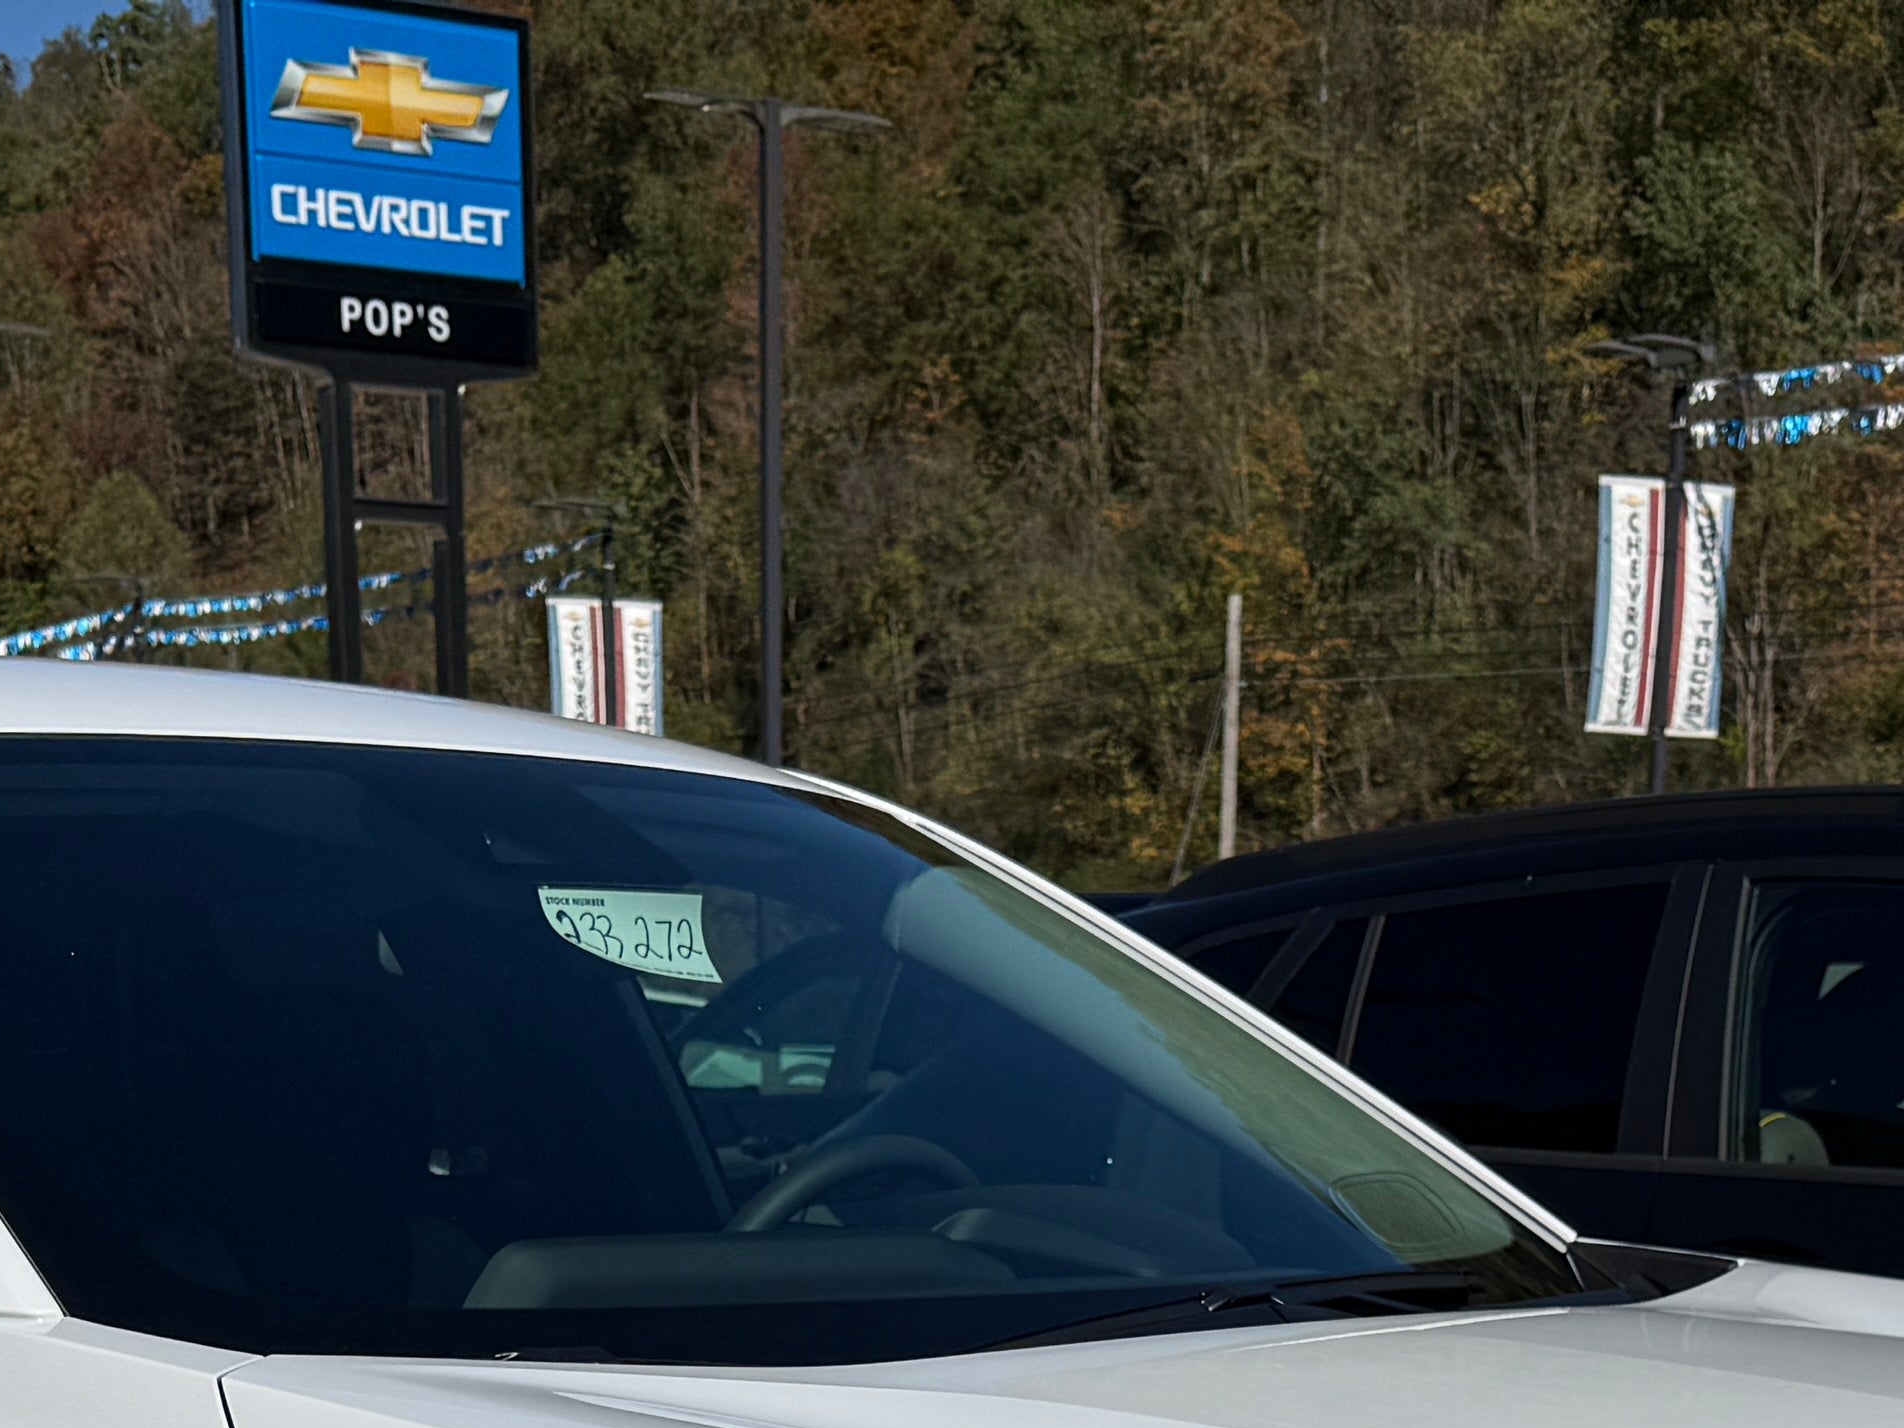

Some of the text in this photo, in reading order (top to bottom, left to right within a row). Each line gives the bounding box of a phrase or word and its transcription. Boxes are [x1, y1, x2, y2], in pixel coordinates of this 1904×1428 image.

[270, 182, 511, 247] CHEVROLET
[339, 295, 452, 344] POP'S
[545, 896, 605, 908] STOCK NUMBER
[634, 916, 703, 963] 272
